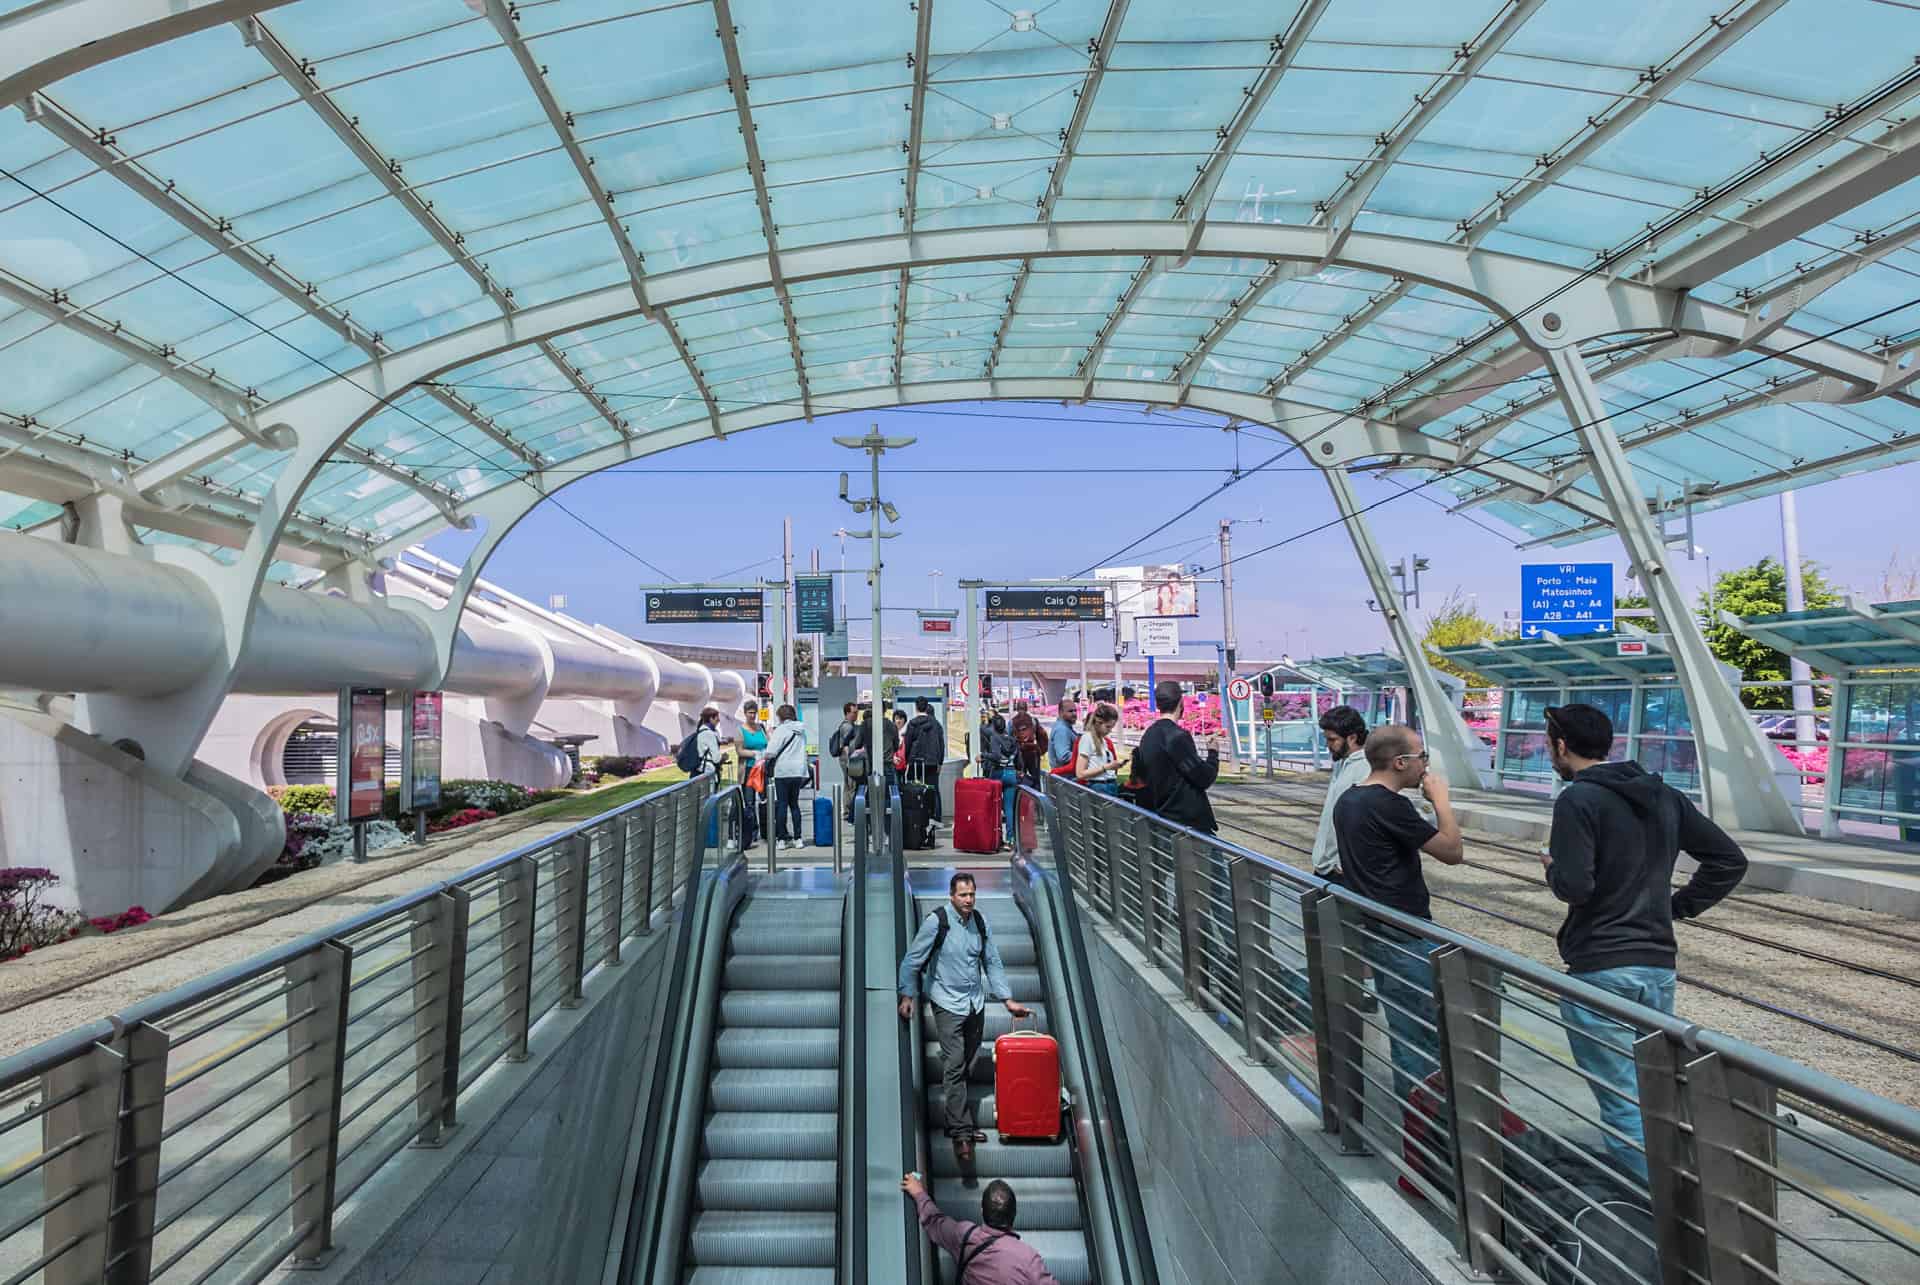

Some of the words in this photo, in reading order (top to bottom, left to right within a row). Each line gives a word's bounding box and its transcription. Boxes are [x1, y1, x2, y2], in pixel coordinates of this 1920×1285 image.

[1537, 577, 1561, 585] Porto
[1575, 576, 1597, 584] Maia
[1542, 589, 1592, 597] Matosinhos
[703, 598, 722, 607] Cais
[1044, 596, 1064, 605] Cais
[1532, 600, 1549, 609] (A1)
[1562, 600, 1575, 608] A3
[1589, 599, 1602, 608] A4
[1575, 611, 1592, 619] A41
